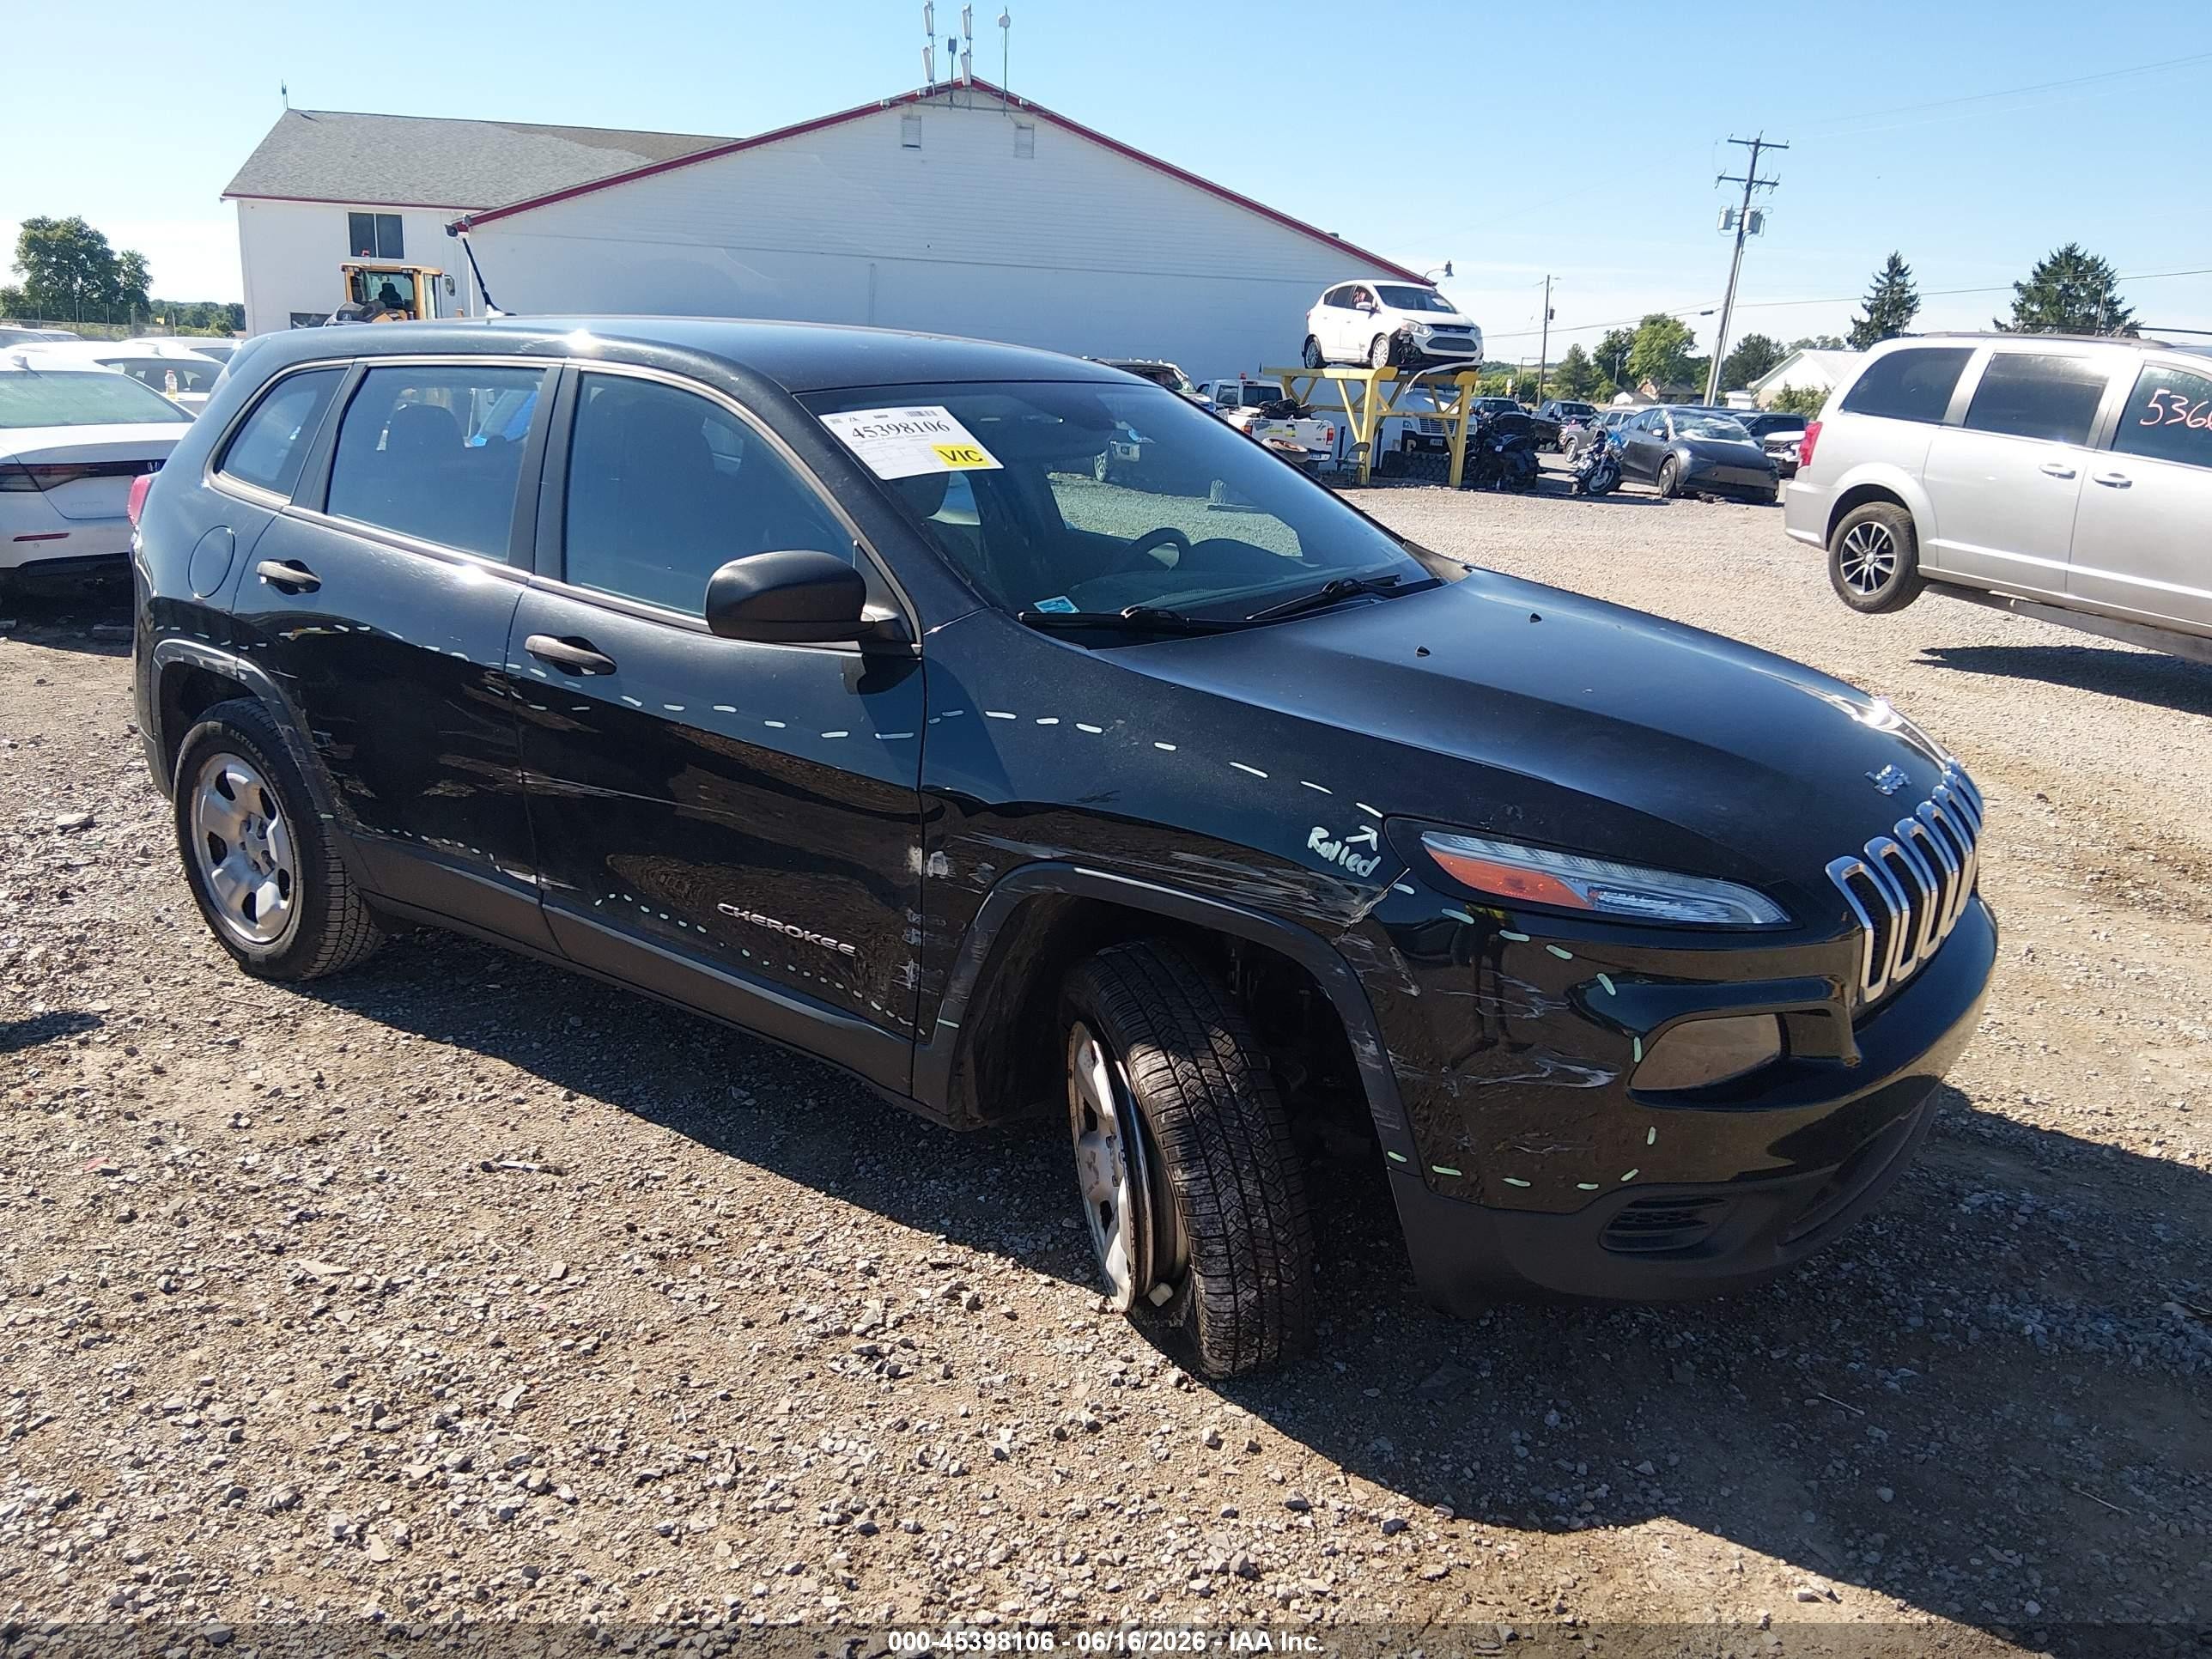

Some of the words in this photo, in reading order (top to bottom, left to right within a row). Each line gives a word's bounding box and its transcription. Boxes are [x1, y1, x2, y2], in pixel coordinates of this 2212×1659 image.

[852, 420, 950, 439] 45398106
[939, 449, 983, 463] VIC
[717, 902, 856, 957] CHEROKEE
